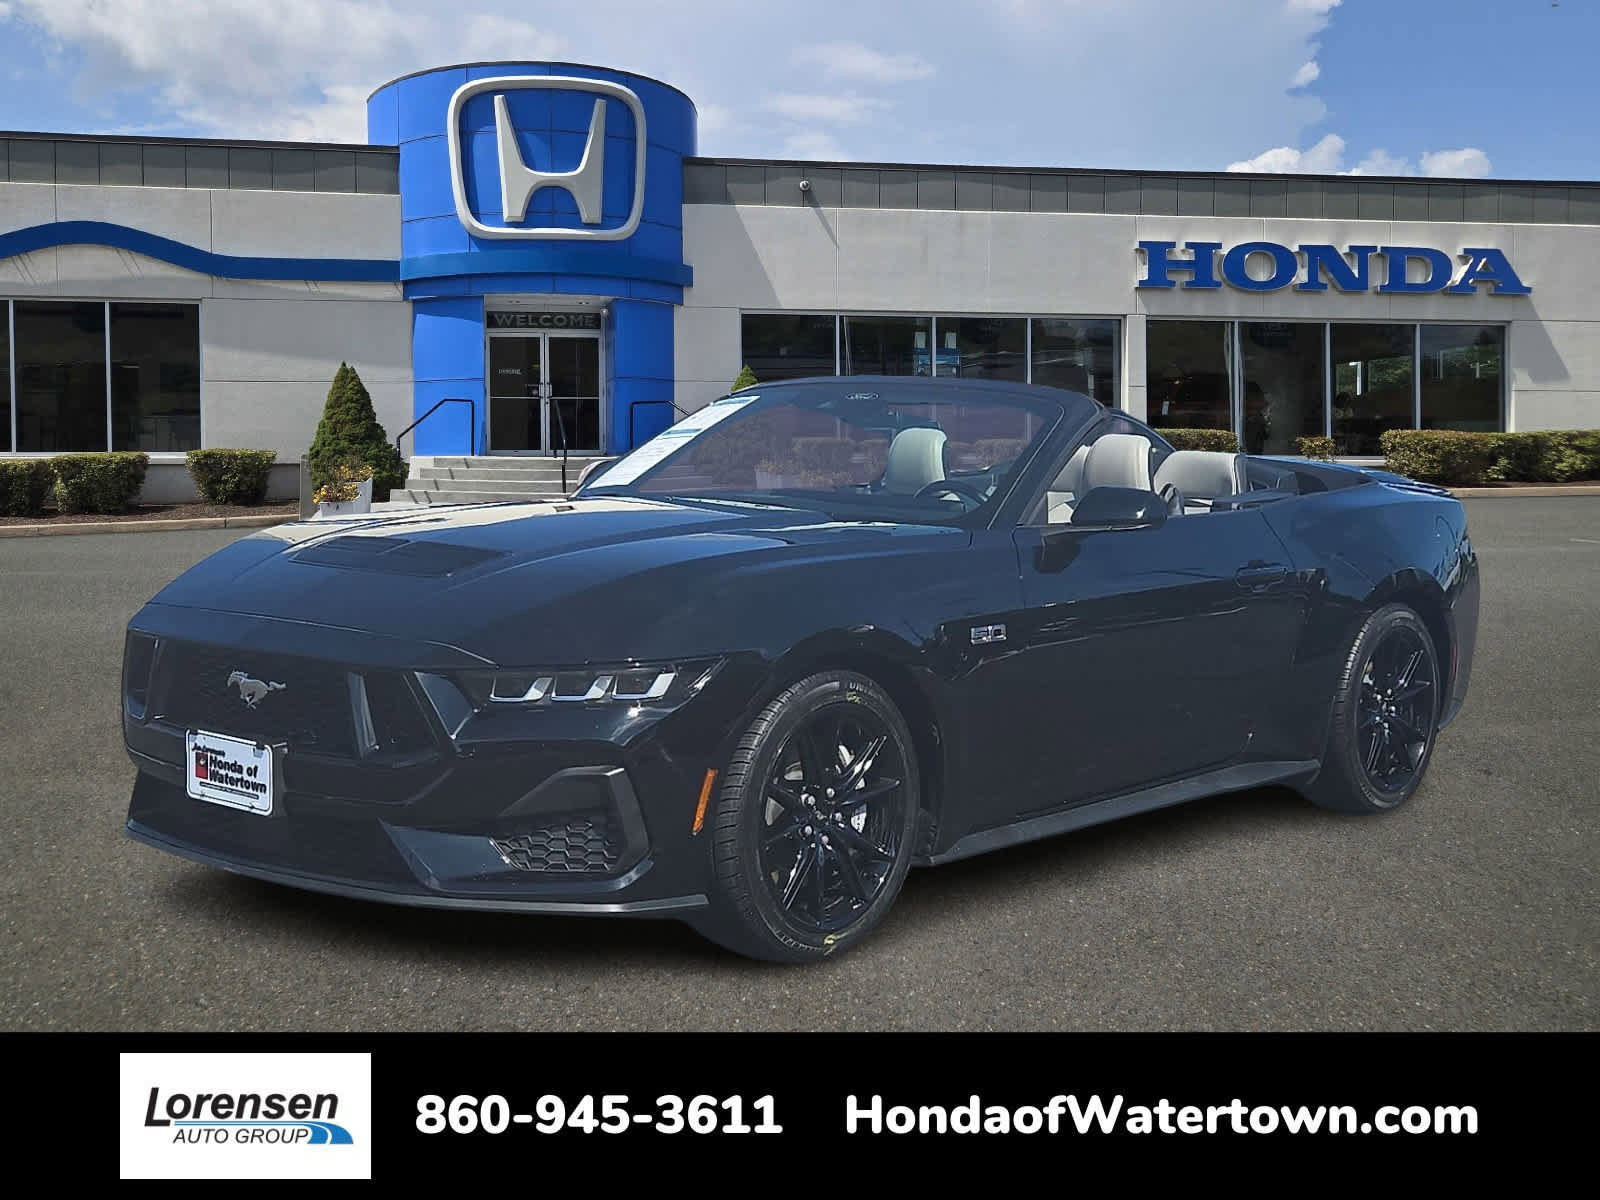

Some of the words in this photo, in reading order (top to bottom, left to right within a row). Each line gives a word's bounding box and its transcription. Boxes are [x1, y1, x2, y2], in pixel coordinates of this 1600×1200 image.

[1136, 241, 1532, 294] HONDA
[494, 313, 595, 326] WELCOME
[209, 755, 244, 775] Honda
[246, 765, 259, 779] of
[209, 768, 267, 794] Watertown
